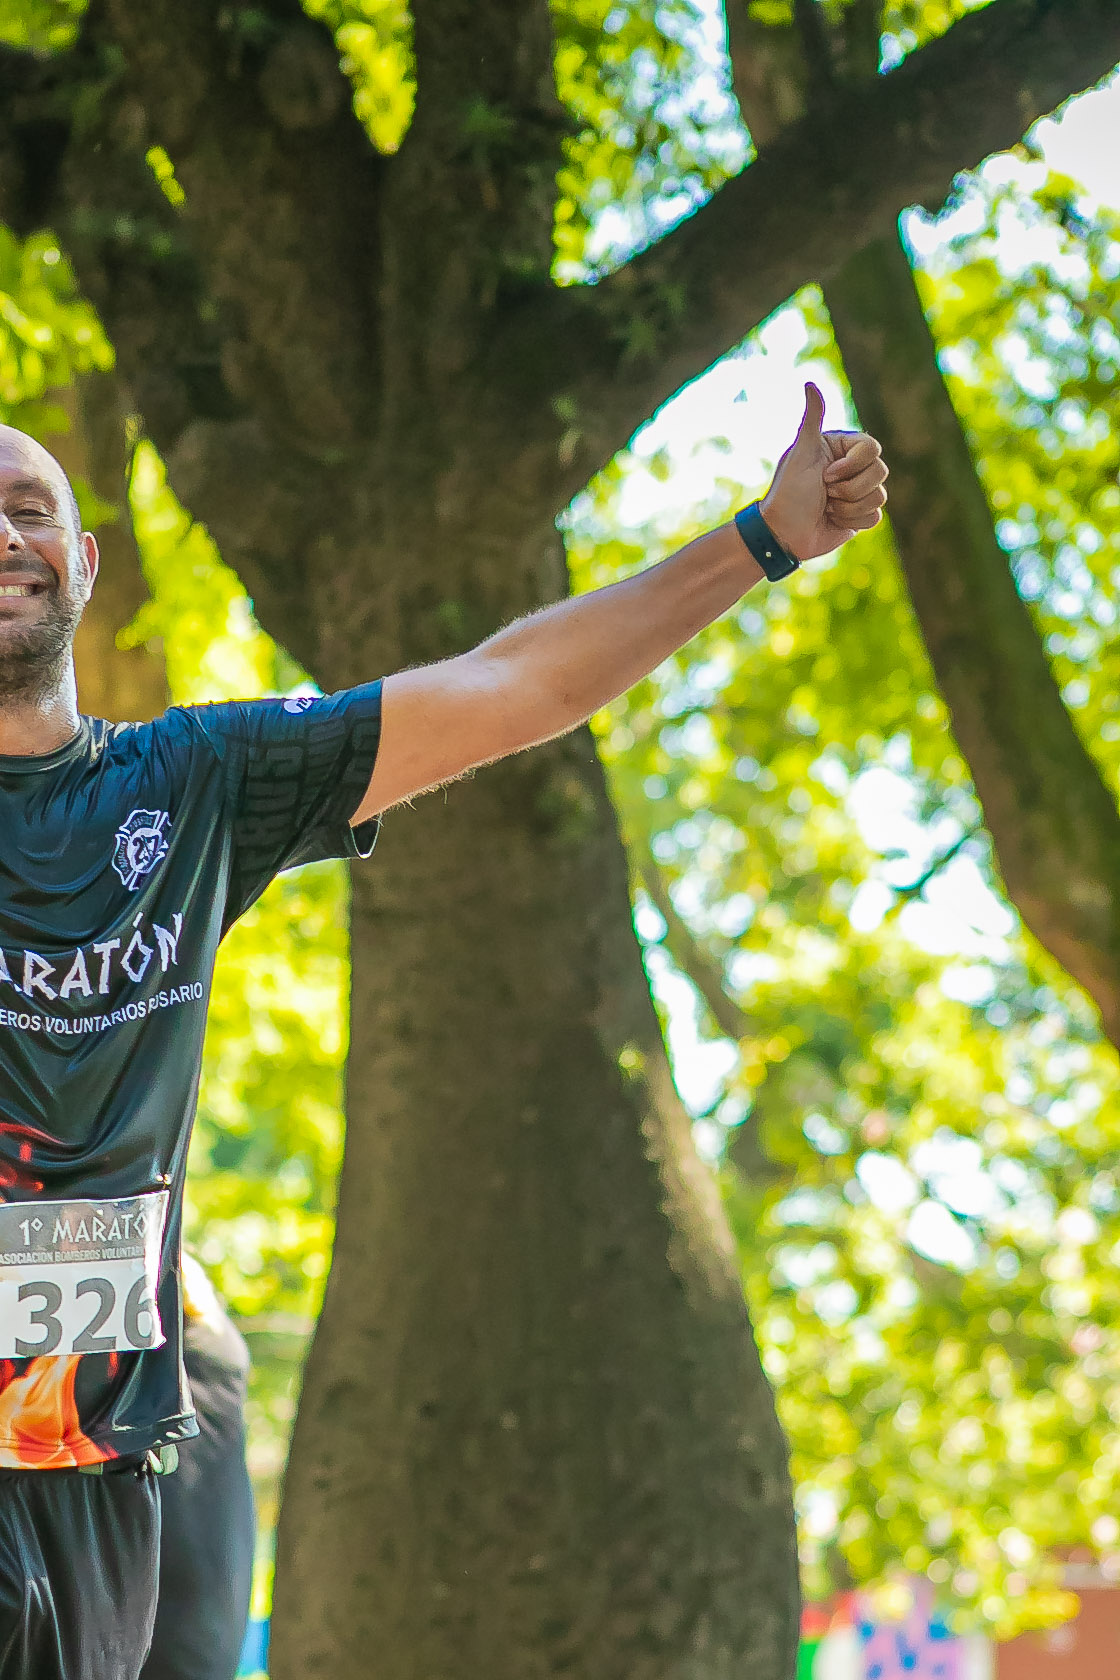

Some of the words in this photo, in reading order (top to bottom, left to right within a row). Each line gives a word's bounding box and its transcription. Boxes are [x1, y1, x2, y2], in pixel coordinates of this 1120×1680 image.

[44, 1001, 147, 1035] VOLUNTARIOS
[52, 1204, 149, 1244] MARATÓ
[14, 1275, 156, 1358] 326
